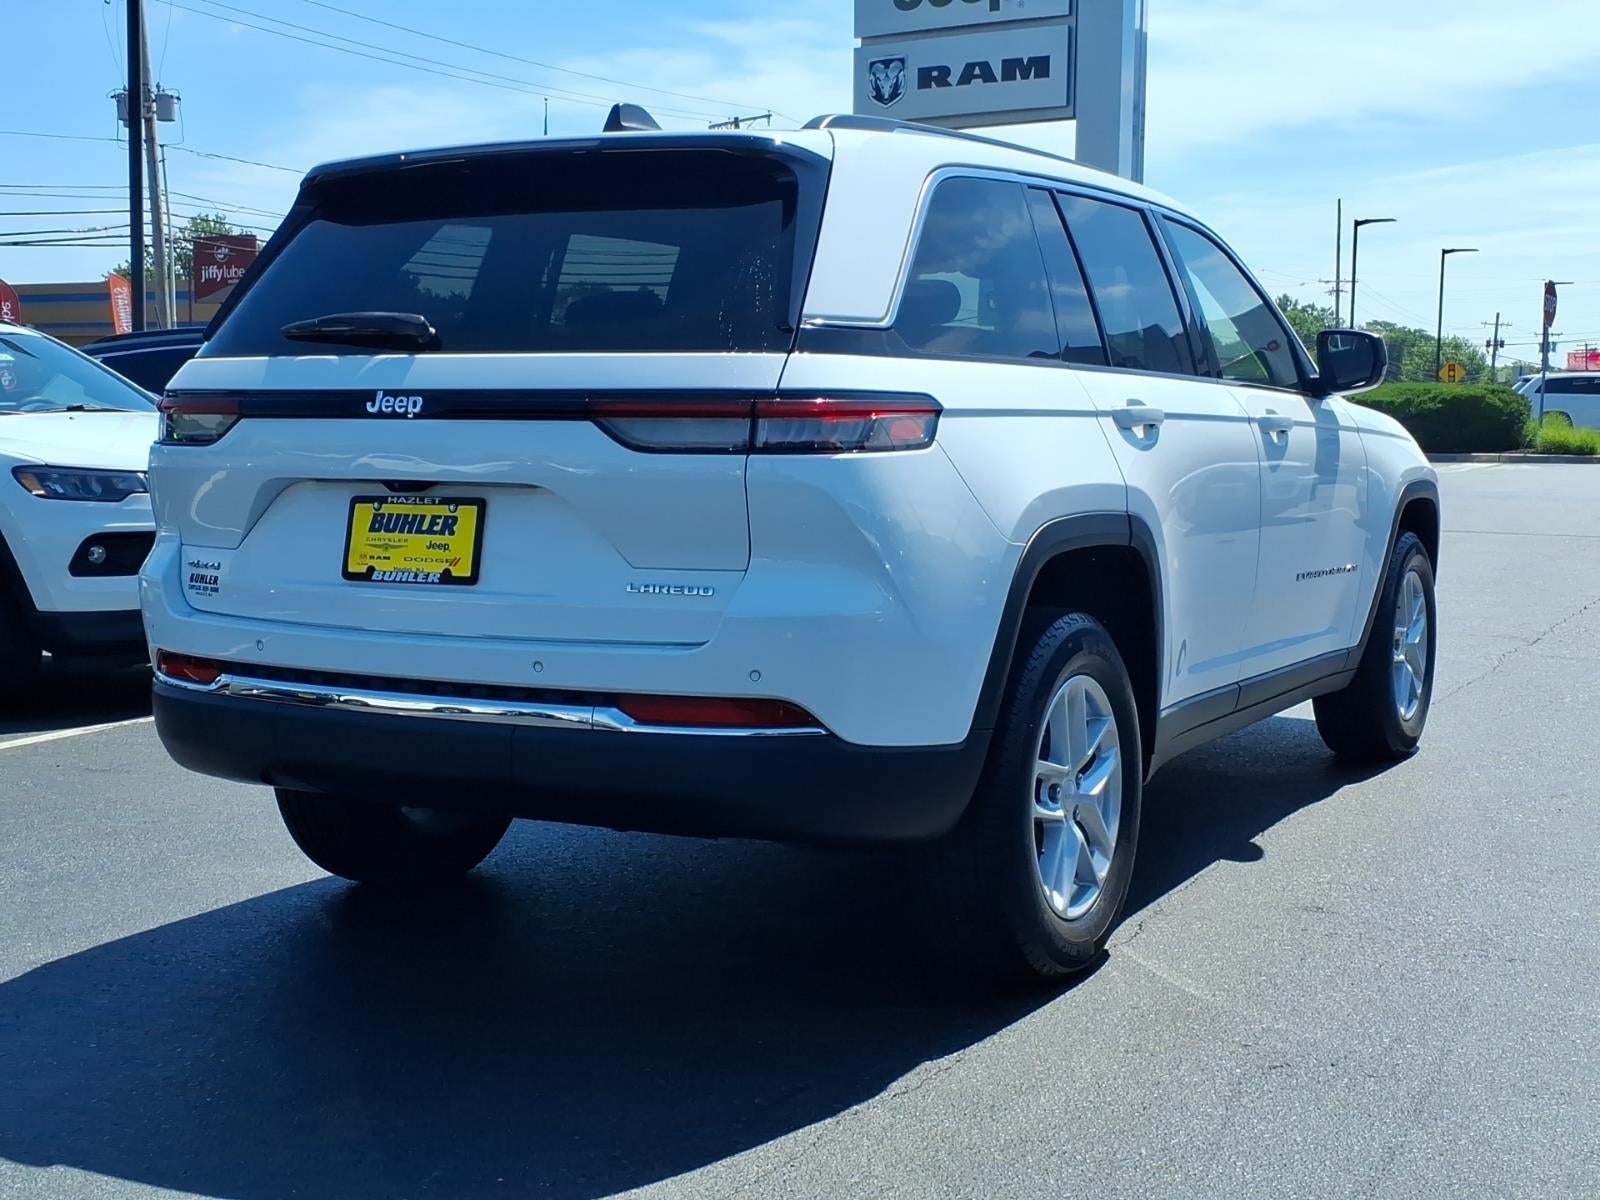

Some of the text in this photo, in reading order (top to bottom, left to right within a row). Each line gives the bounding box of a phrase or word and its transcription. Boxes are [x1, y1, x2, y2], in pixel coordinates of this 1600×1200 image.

[917, 55, 1050, 90] RAM
[366, 390, 423, 418] Jeep
[387, 496, 441, 505] HAZLET
[368, 512, 459, 536] BUHLER
[426, 540, 451, 552] Jeep
[404, 556, 454, 564] DODGE
[189, 573, 219, 585] BUHLER
[371, 571, 441, 583] BUHLER
[626, 582, 715, 596] LAREDO
